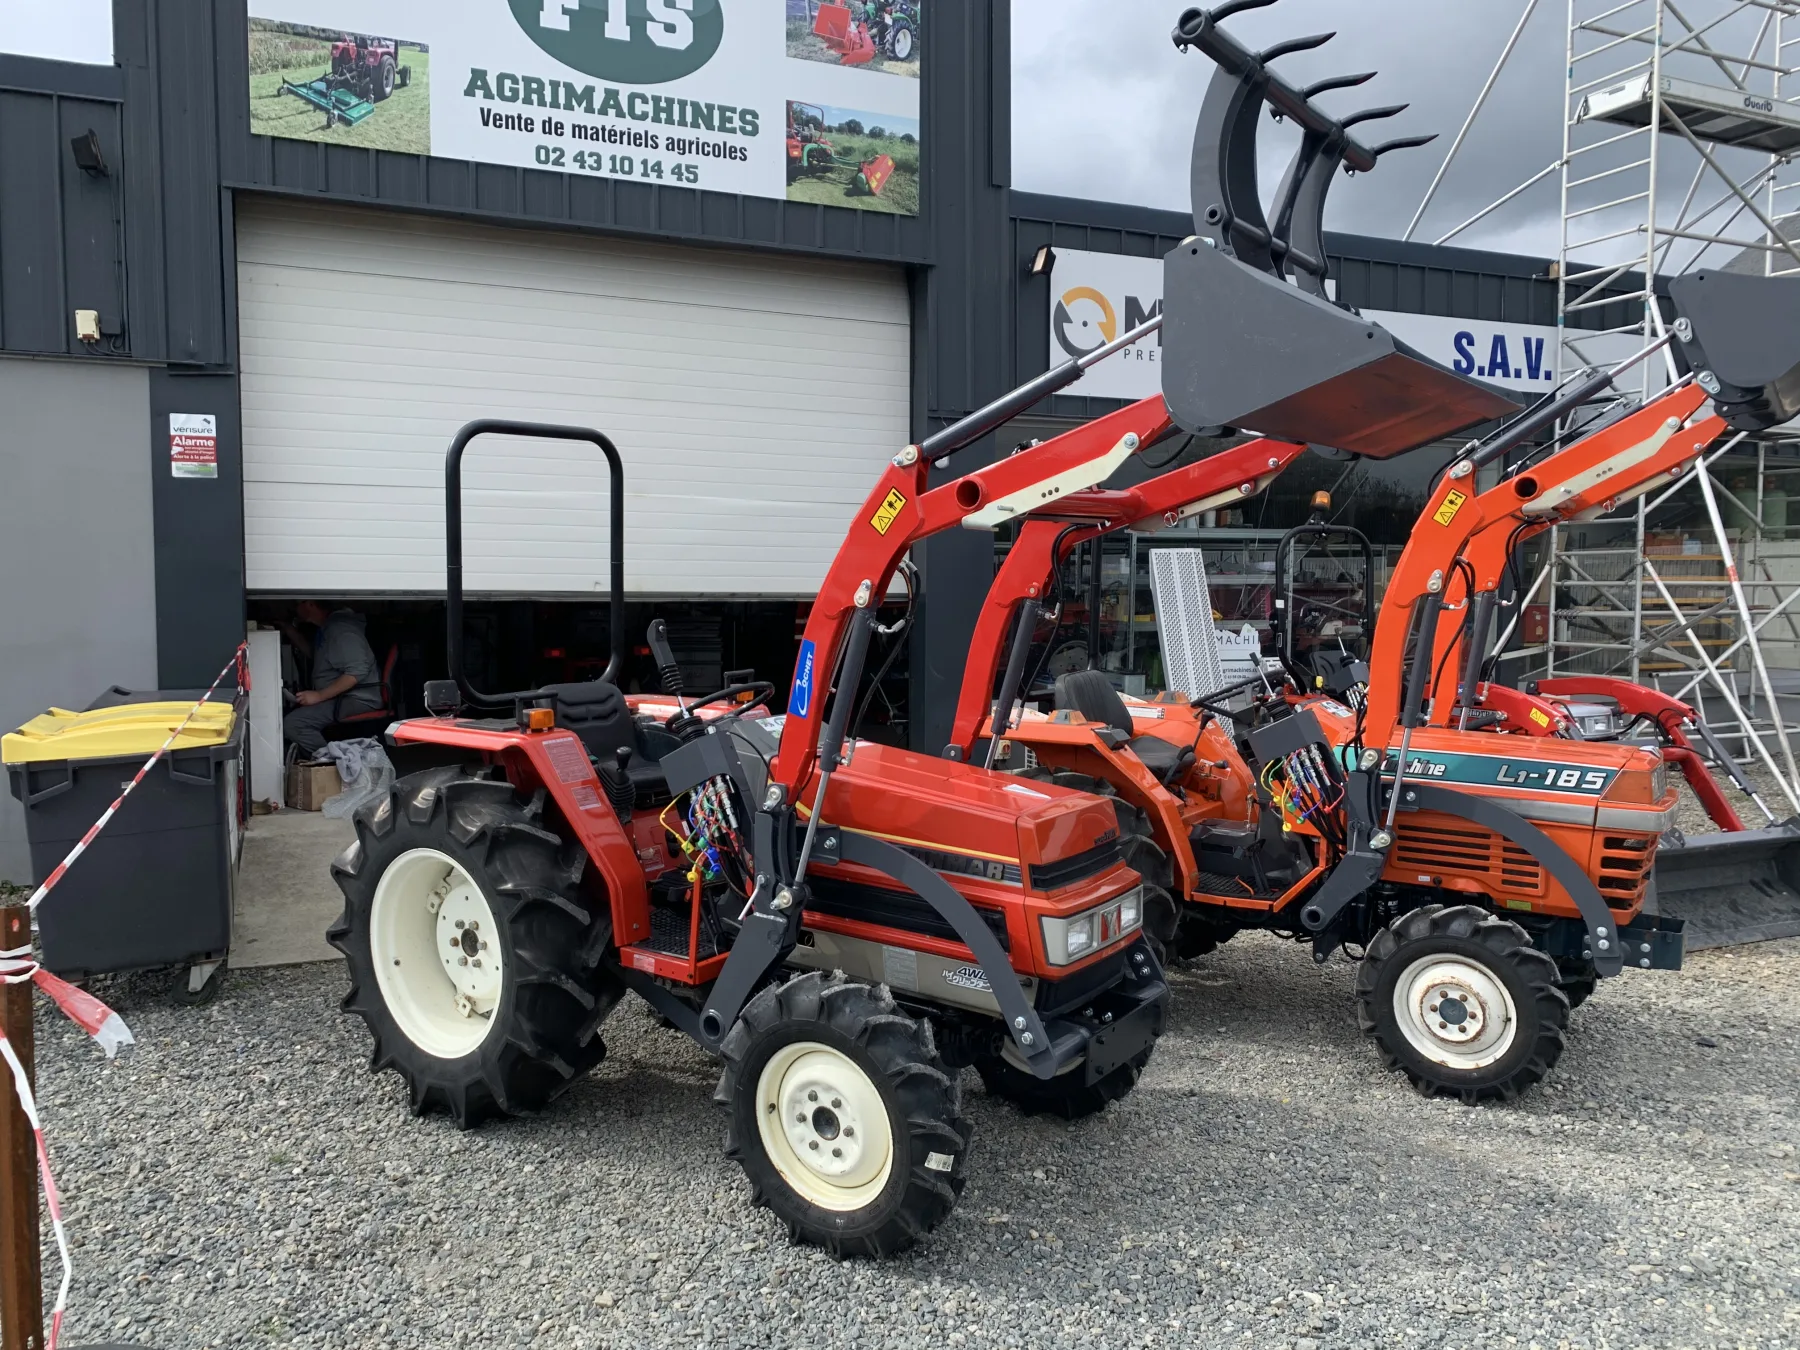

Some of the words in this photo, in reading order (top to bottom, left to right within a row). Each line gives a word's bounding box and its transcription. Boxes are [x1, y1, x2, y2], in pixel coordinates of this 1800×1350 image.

[464, 67, 760, 137] AGRIMACHINES
[479, 106, 535, 133] Vente
[541, 116, 565, 137] de
[571, 122, 659, 150] matériels
[665, 136, 748, 162] agricoles
[535, 144, 565, 167] 02
[572, 150, 602, 171] 43
[608, 154, 634, 175] 10
[640, 158, 664, 179] 14
[670, 162, 699, 184] 45
[1123, 348, 1156, 362] PRE
[1453, 330, 1552, 381] S.A.V.
[172, 426, 213, 434] verisure
[172, 435, 215, 447] Alarme
[1215, 635, 1260, 646] MACHI
